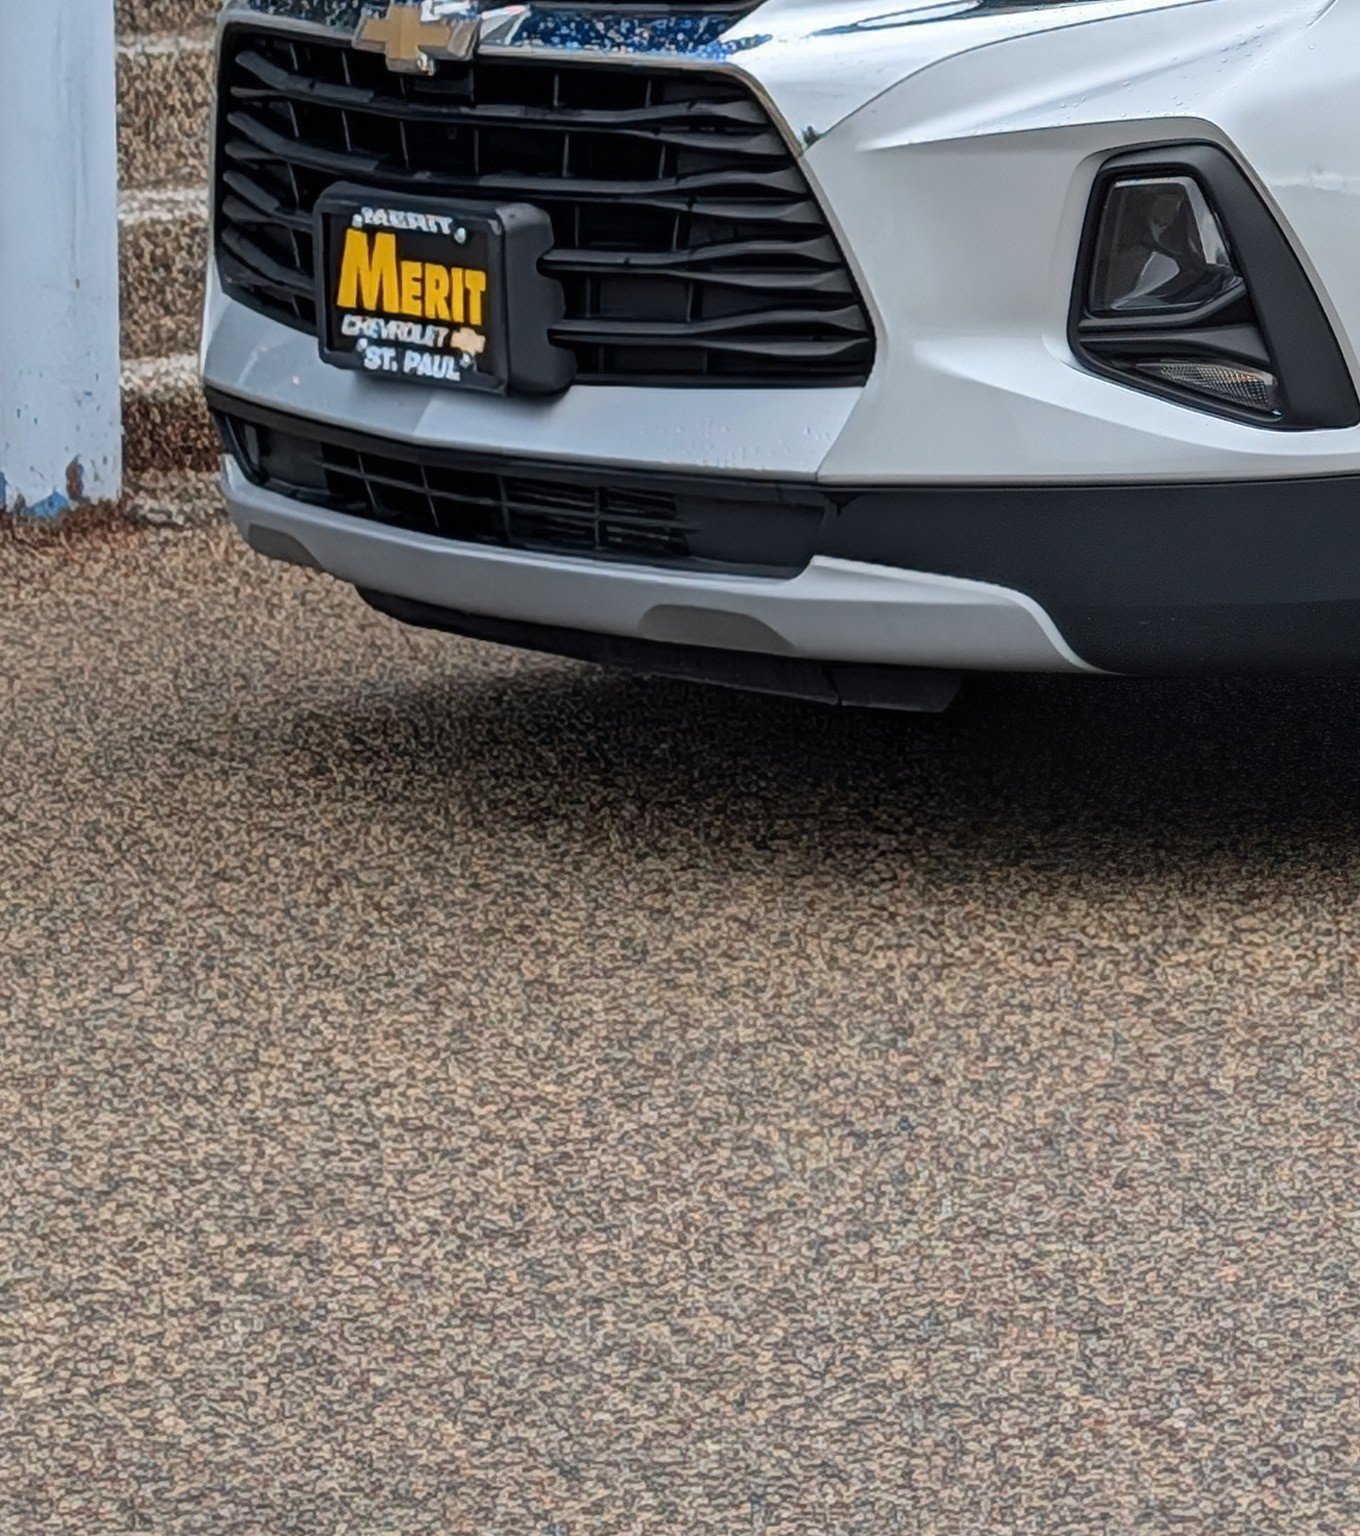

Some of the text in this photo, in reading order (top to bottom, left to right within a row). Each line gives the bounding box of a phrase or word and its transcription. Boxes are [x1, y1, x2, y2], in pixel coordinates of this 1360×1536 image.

[337, 228, 486, 326] MERIT
[341, 314, 450, 348] CHEVROLET
[364, 345, 461, 381] ST. PAUL
